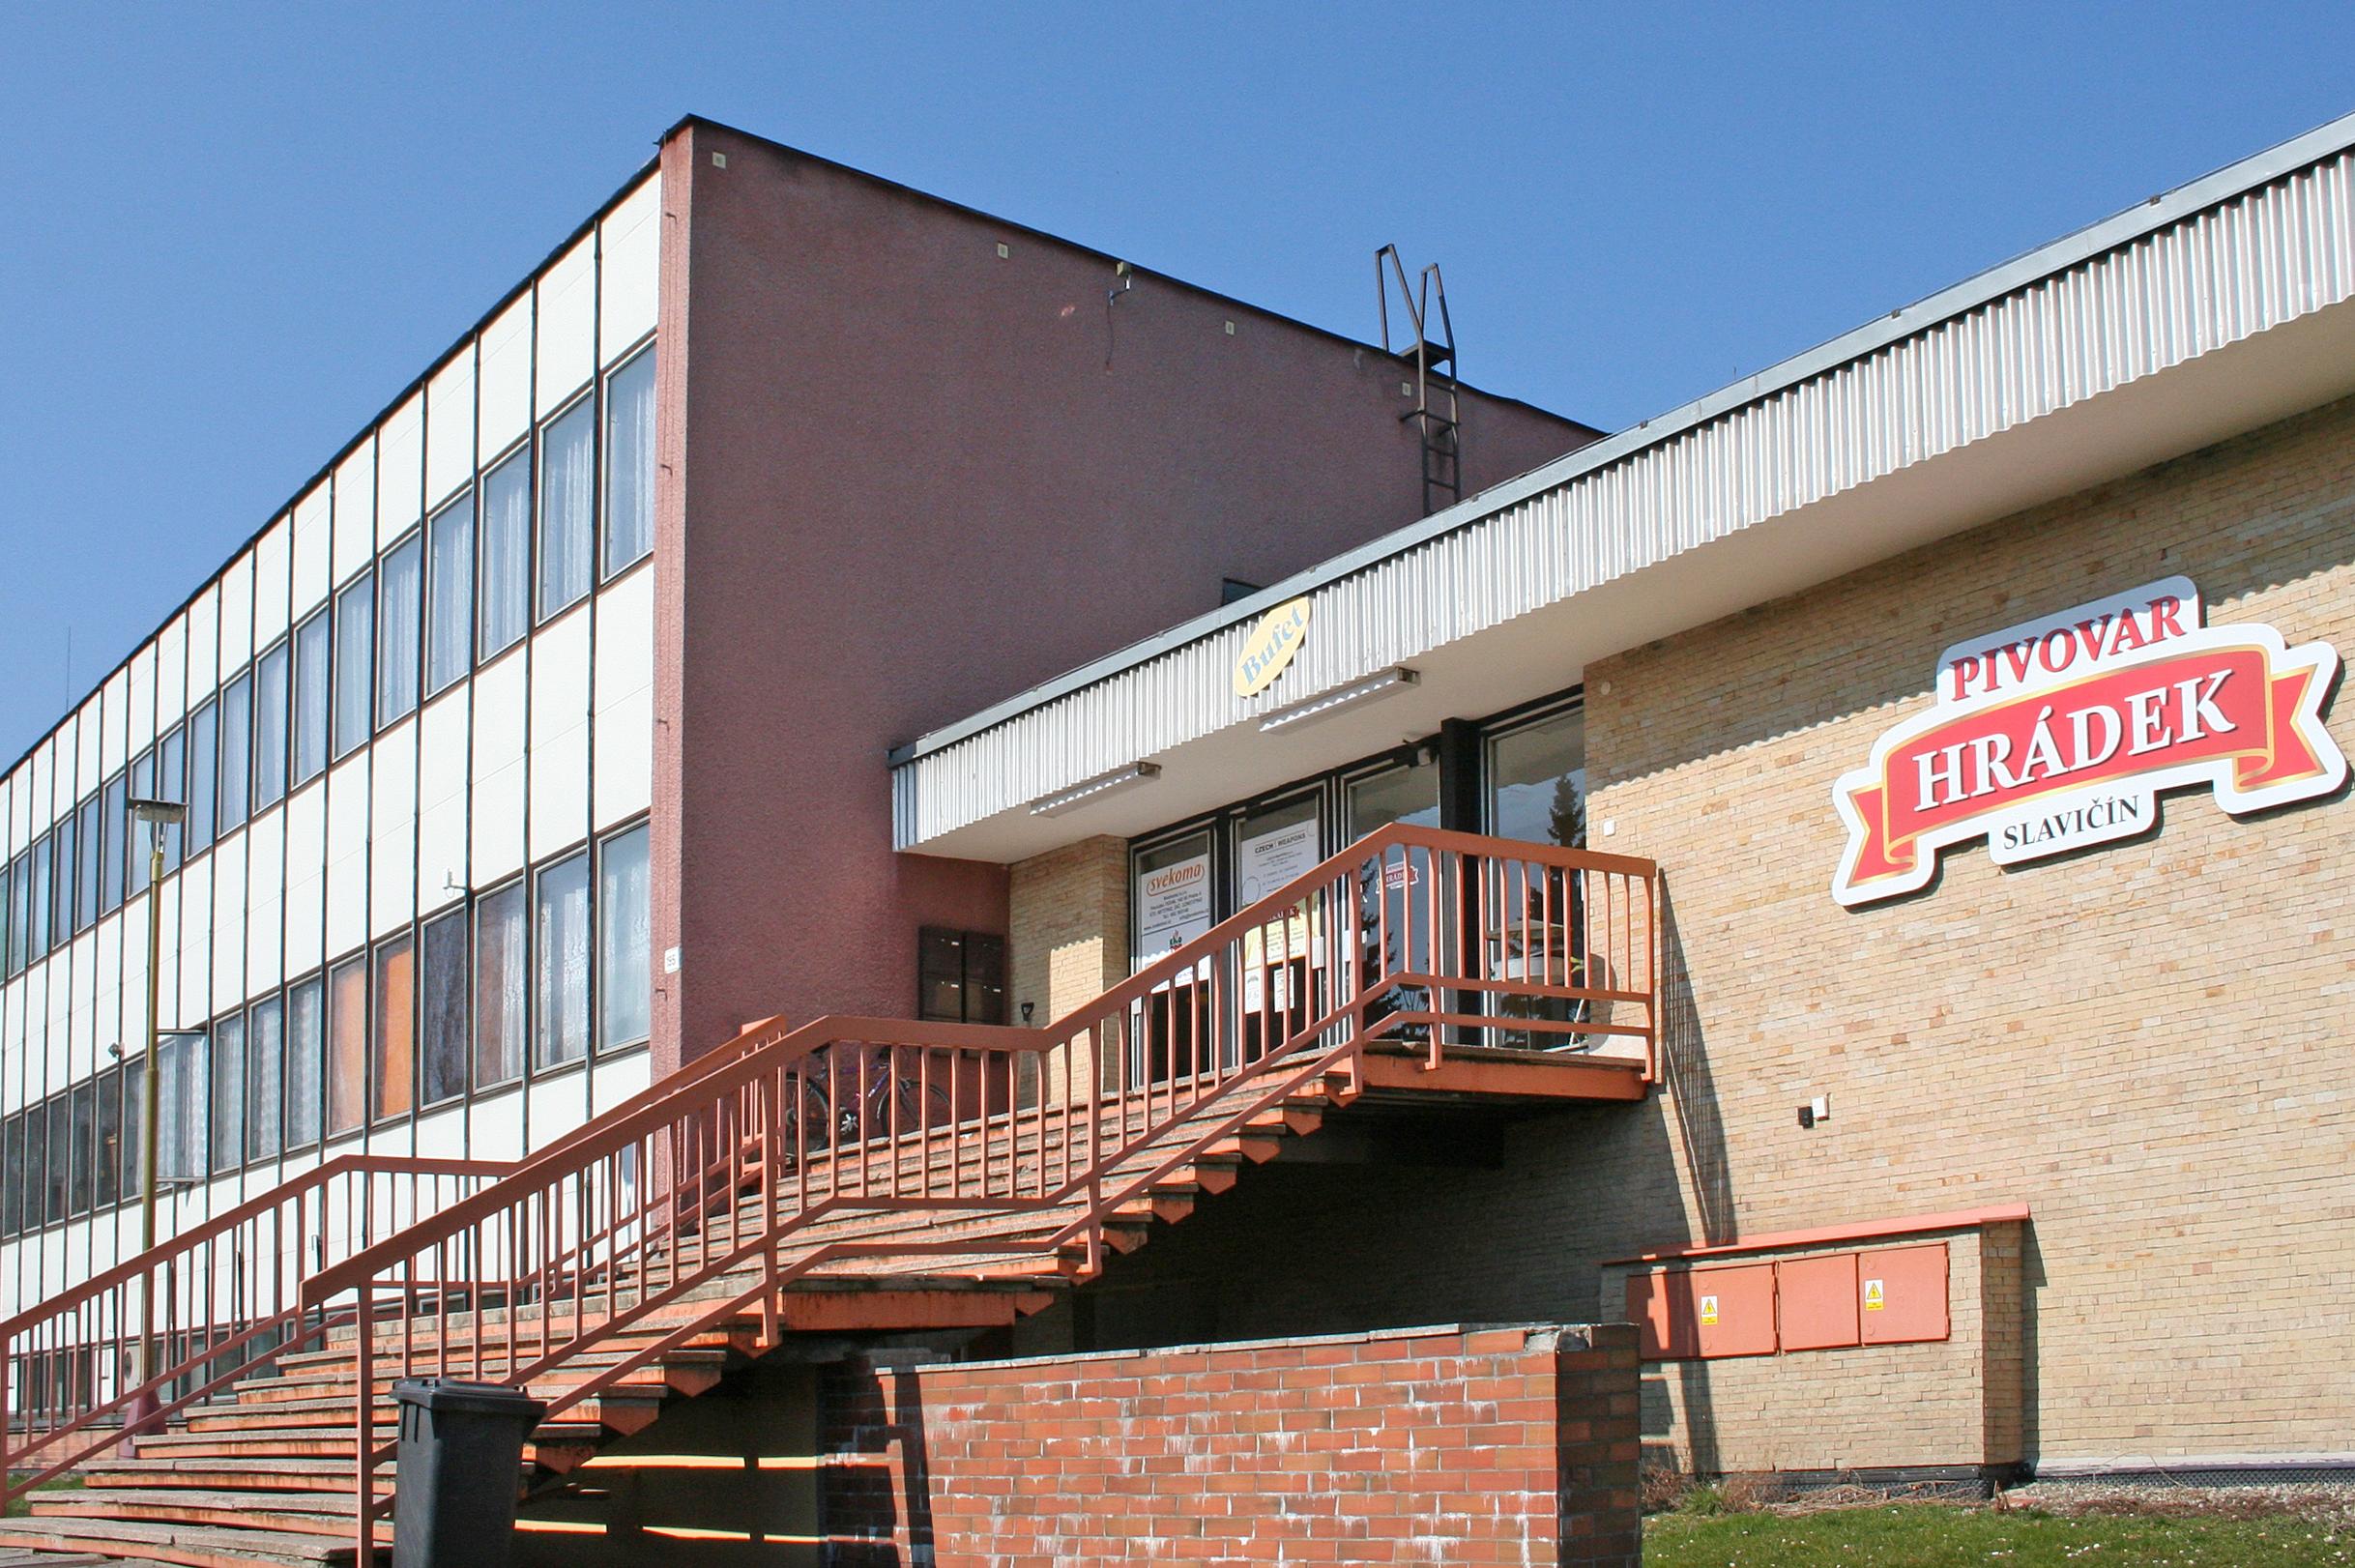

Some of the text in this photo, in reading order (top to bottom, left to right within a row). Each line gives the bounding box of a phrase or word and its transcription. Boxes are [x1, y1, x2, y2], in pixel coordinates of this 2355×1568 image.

[1241, 604, 1303, 686] Bufet
[1949, 595, 2187, 702] PIVOVAR
[1911, 669, 2236, 812] HRÁDEK
[1255, 832, 1306, 854] CZECH WEAPONS
[2003, 795, 2139, 851] SLAVIČÍN
[1149, 863, 1202, 892] svekoma
